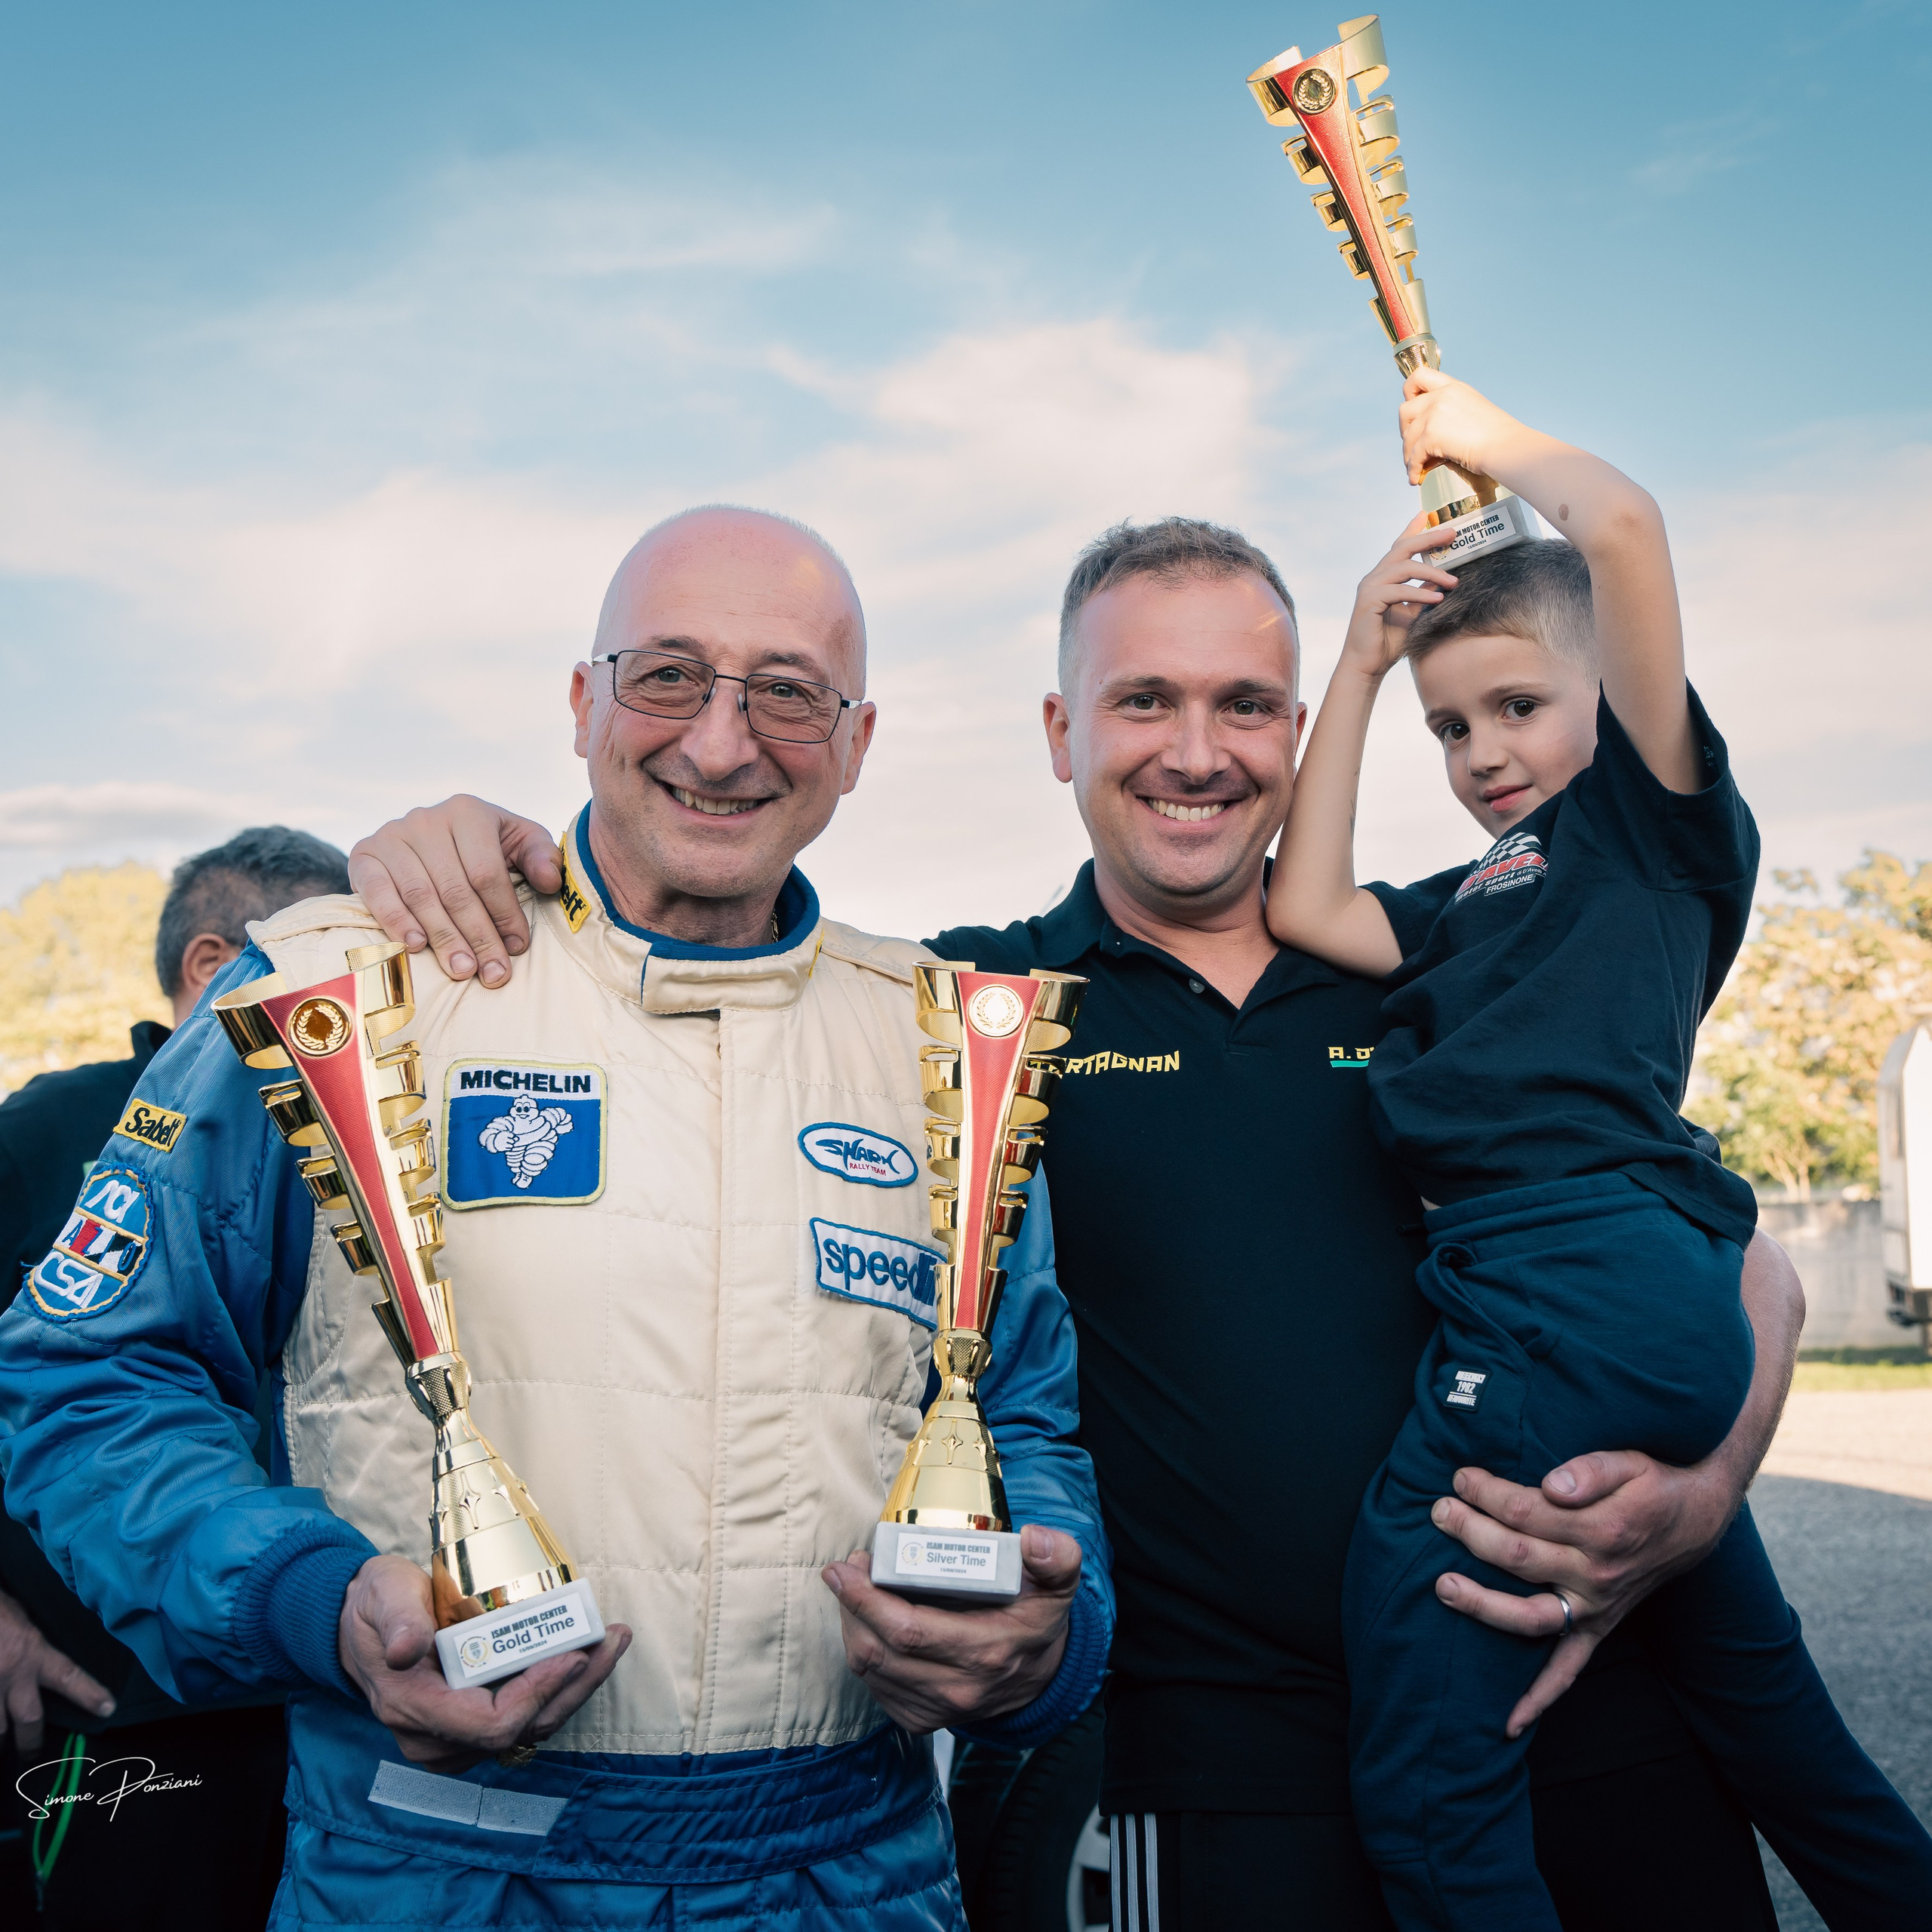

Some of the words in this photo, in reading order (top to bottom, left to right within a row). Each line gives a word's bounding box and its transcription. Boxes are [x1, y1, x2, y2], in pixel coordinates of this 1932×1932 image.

[1450, 534, 1476, 550] Gold
[1477, 523, 1505, 538] Time
[1463, 522, 1481, 535] MOTOR
[1481, 515, 1500, 526] CENTER
[1455, 852, 1548, 898] D'AVEL
[1484, 872, 1515, 886] sport
[1486, 874, 1534, 894] FROSINONE
[1031, 1050, 1179, 1075] RTAGNAN
[460, 1069, 591, 1093] MICHELIN
[125, 1106, 182, 1146] Sabelt
[815, 1138, 900, 1174] SHARK
[871, 1166, 887, 1176] TEAM
[927, 1542, 943, 1550] ISAM
[943, 1543, 966, 1552] MOTOR
[968, 1545, 990, 1554] CENTER
[927, 1552, 958, 1564] Silver
[961, 1555, 986, 1567] Time
[491, 1625, 512, 1639] ISAM
[512, 1614, 539, 1632] MOTOR
[540, 1604, 568, 1622] CENTER
[493, 1629, 531, 1654] Gold
[534, 1617, 575, 1638] Time
